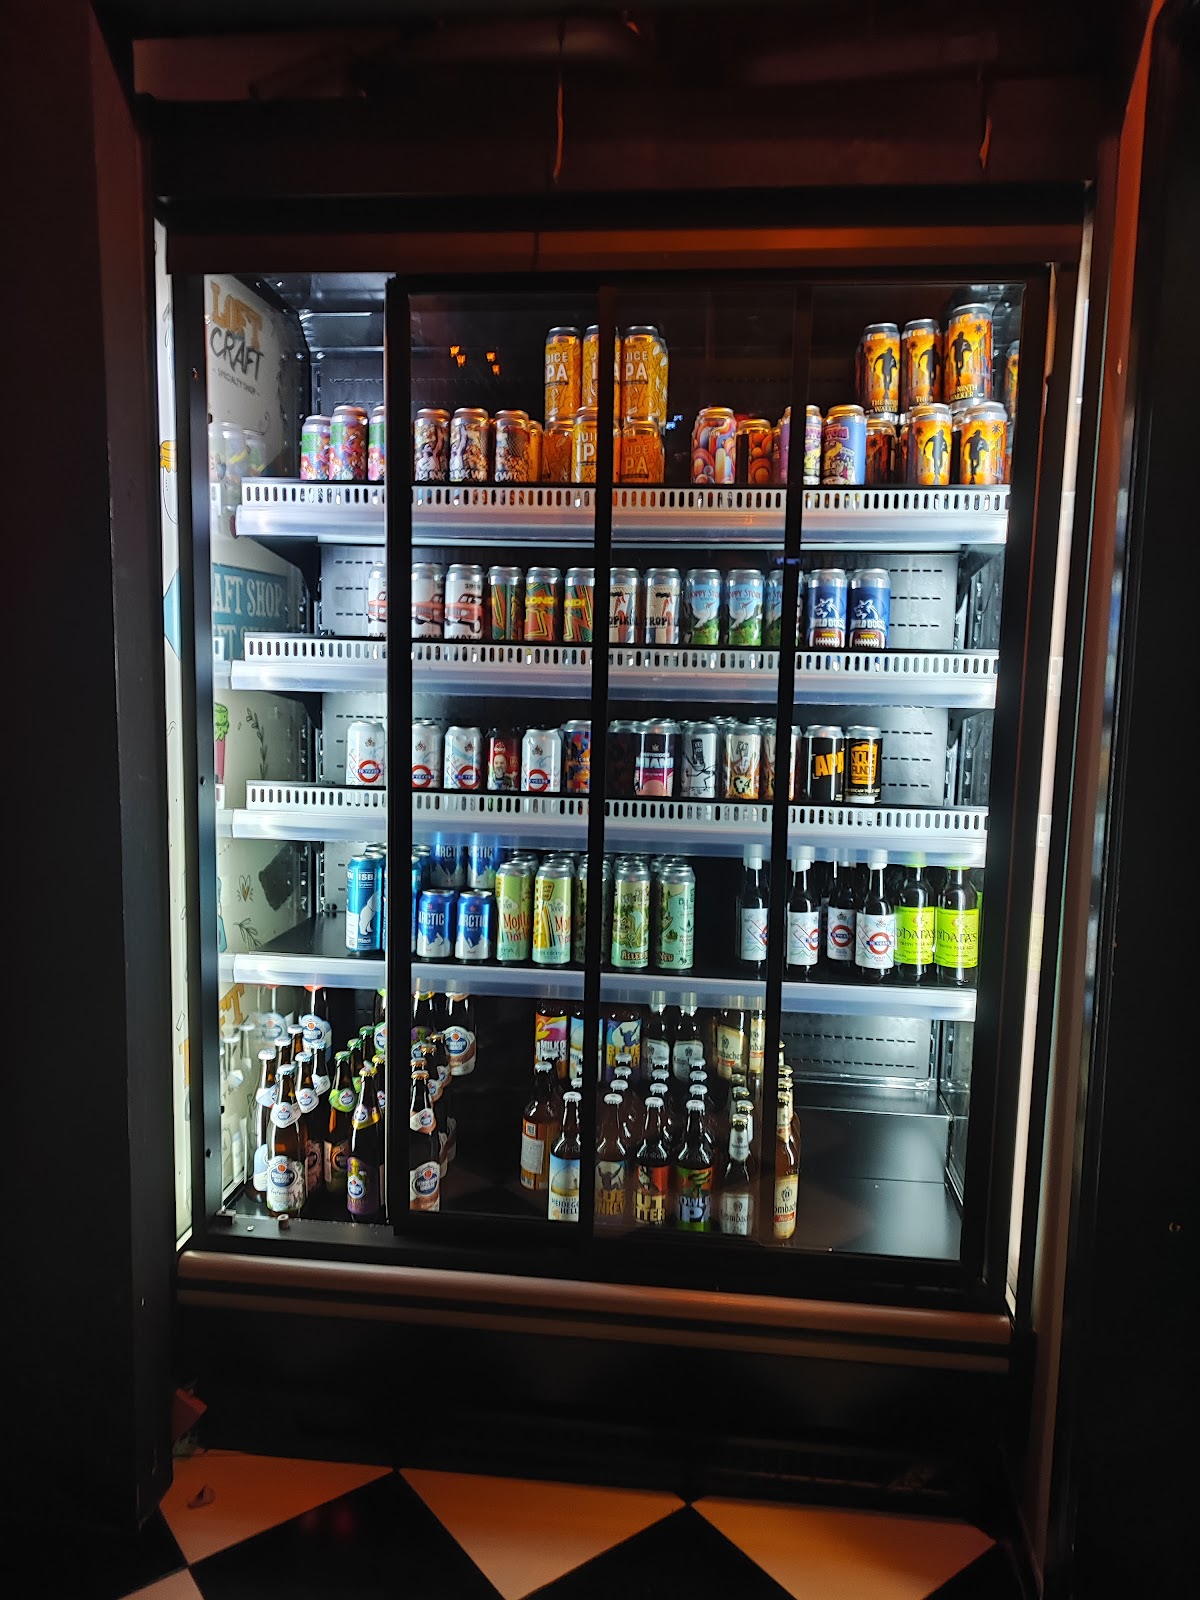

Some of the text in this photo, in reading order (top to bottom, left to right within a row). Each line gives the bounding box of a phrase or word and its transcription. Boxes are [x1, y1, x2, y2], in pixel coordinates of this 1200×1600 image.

[210, 327, 264, 380] CRAFT
[246, 578, 282, 618] SHOP
[636, 757, 673, 769] MIAMI
[418, 911, 445, 926] ARCTIC
[459, 914, 490, 928] ARCTIC
